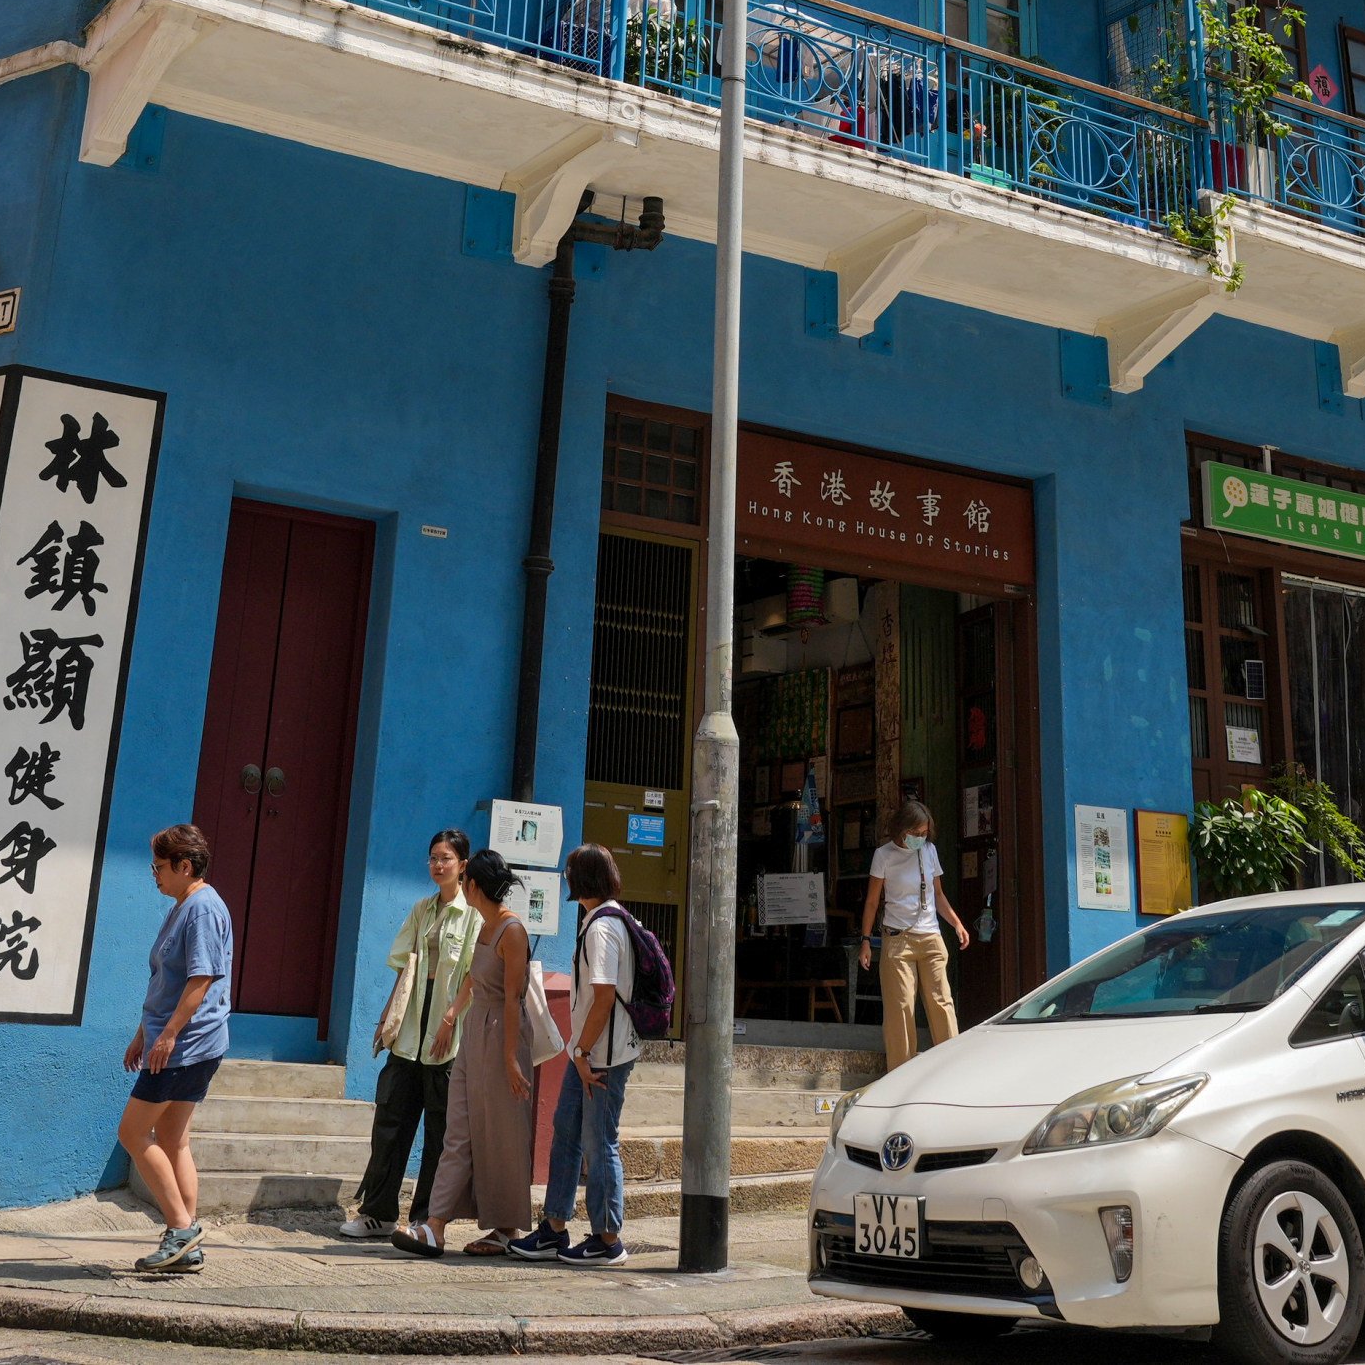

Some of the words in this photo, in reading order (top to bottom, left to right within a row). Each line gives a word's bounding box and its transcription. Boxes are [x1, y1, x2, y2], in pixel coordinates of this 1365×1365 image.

[770, 460, 992, 534] 香港故事館
[748, 501, 793, 523] Hong
[802, 511, 847, 533] Kong
[856, 521, 907, 542] House
[915, 533, 934, 547] Of
[943, 538, 1010, 561] Stories
[1274, 513, 1341, 541] Lisa's
[872, 1195, 899, 1225] VY
[859, 1223, 916, 1257] 3045
